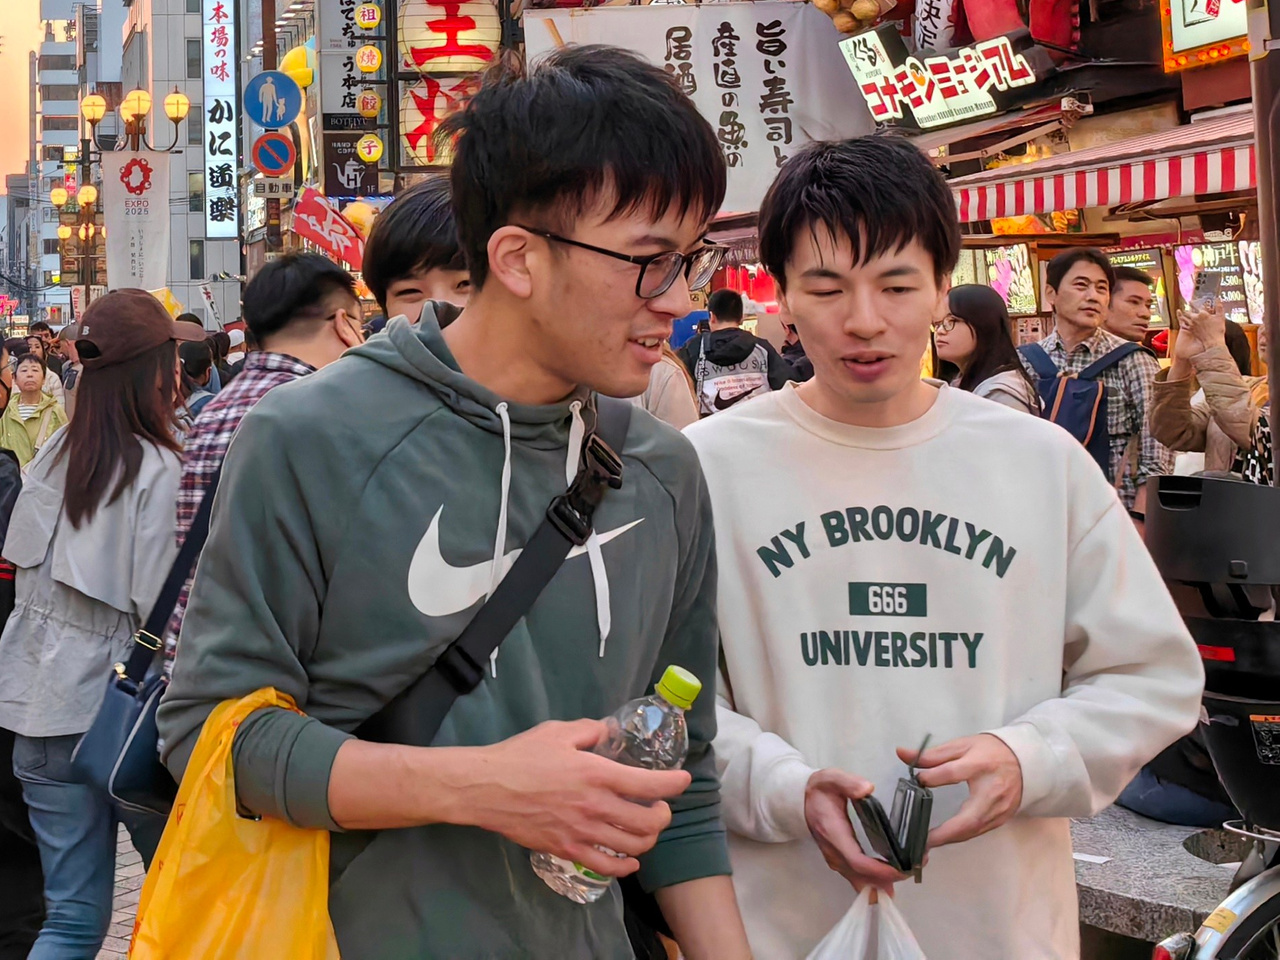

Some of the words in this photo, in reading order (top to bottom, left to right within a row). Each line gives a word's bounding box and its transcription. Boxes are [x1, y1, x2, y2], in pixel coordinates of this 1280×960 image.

[208, 1, 230, 82] 本場の味
[664, 25, 698, 96] 居酒
[712, 21, 748, 168] 産直の魚の
[756, 19, 794, 169] 旨い寿司と
[207, 98, 235, 222] かに道楽
[255, 183, 292, 194] 自動車
[756, 521, 811, 578] NY
[820, 505, 1017, 578] BROOKLYN
[868, 585, 908, 614] 666
[800, 630, 984, 668] UNIVERSITY
